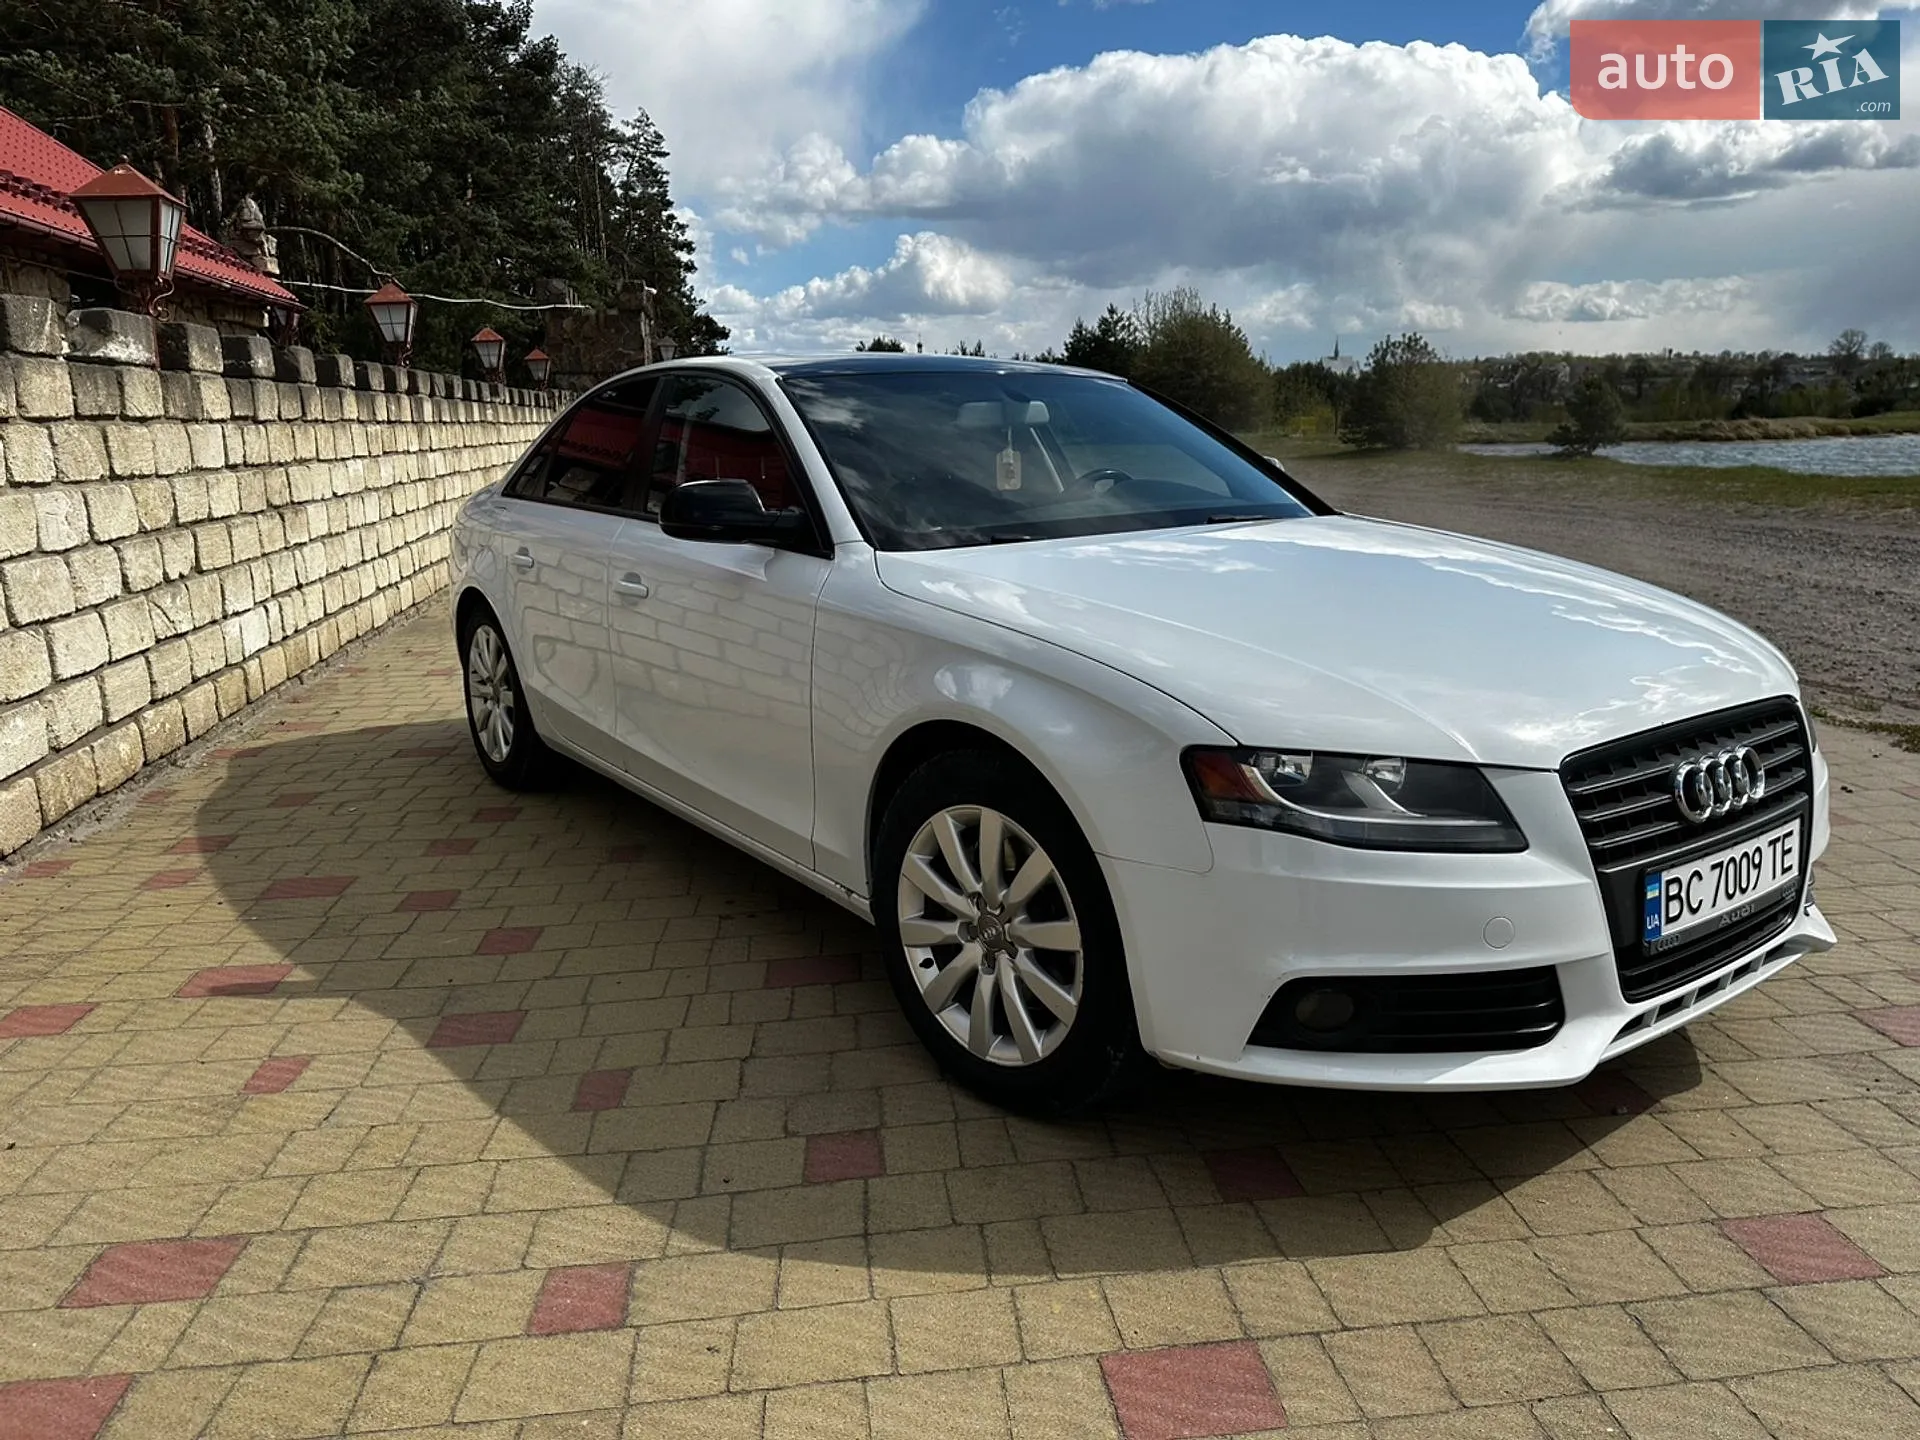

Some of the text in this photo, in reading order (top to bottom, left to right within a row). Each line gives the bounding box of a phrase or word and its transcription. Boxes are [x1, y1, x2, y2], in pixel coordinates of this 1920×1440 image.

[1665, 829, 1794, 925] BC 7009 TE
[1646, 916, 1660, 930] UA
